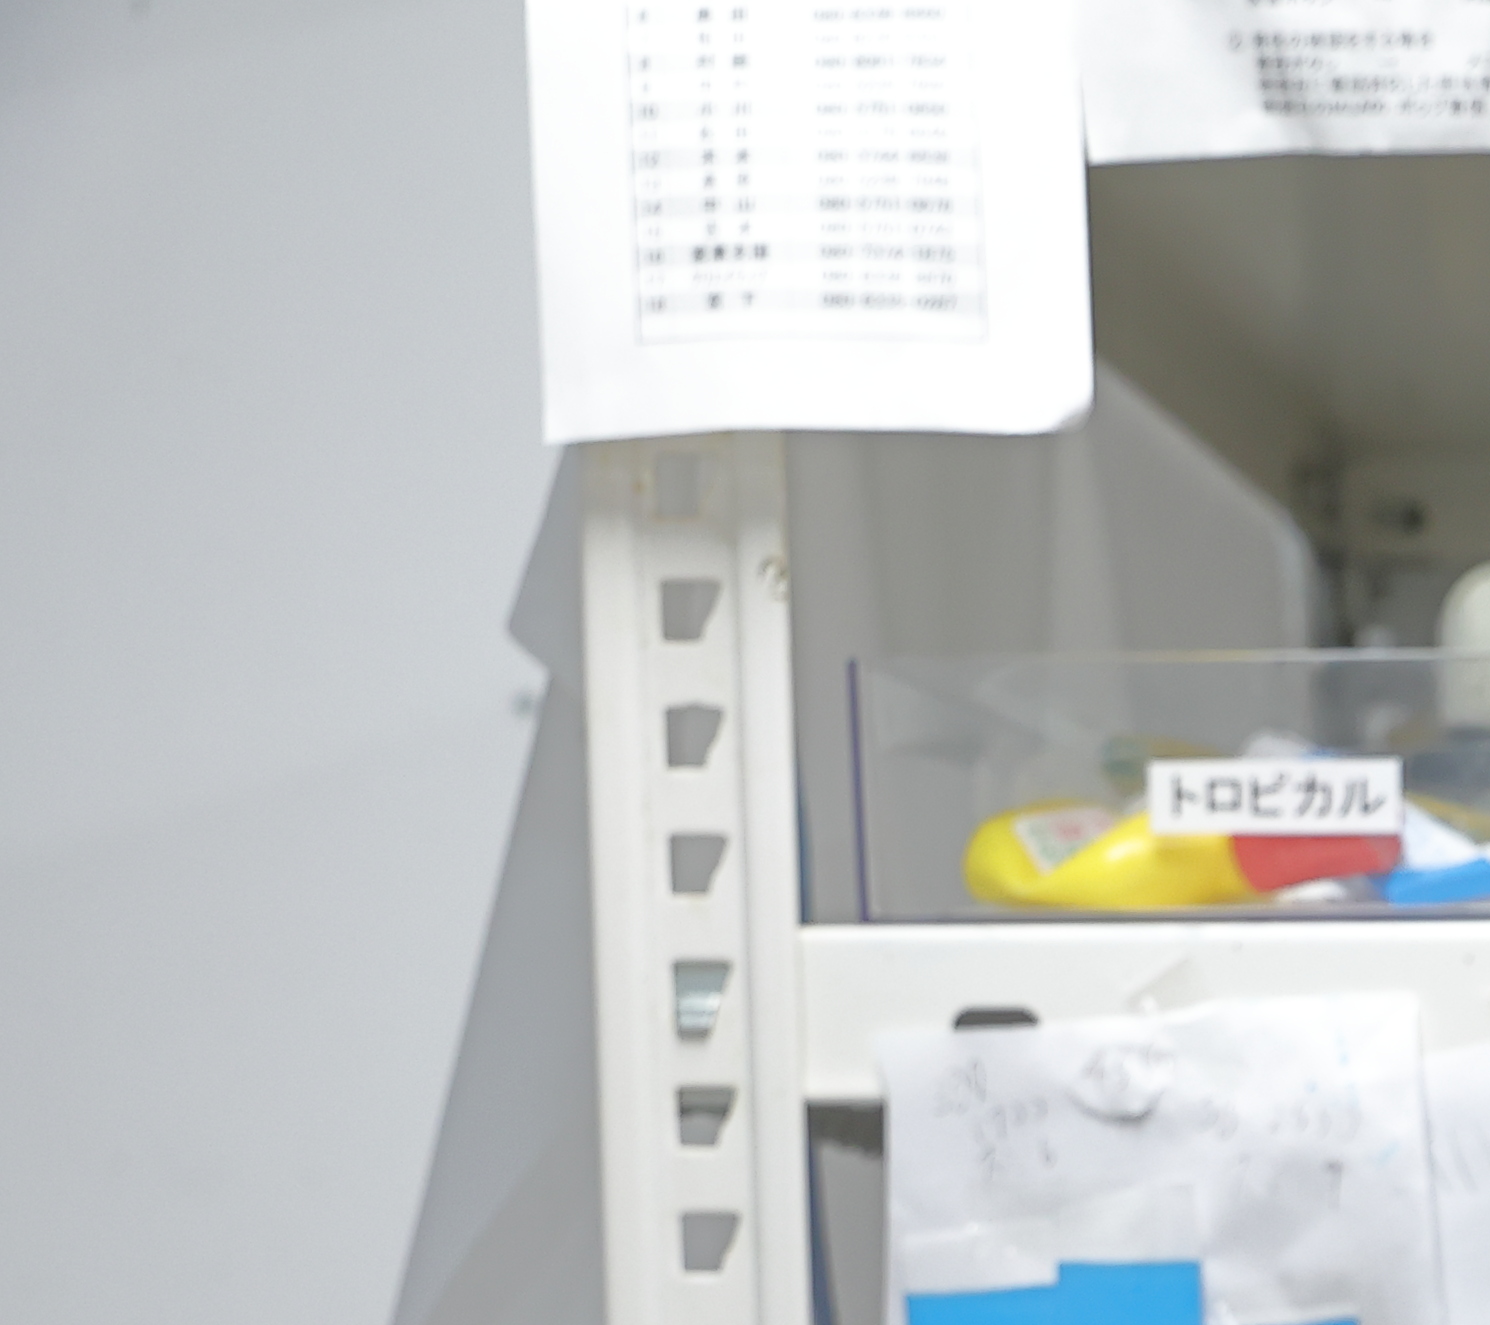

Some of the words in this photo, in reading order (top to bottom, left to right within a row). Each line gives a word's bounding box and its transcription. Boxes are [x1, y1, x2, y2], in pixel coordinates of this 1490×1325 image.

[1170, 772, 1386, 818] トロピカル
